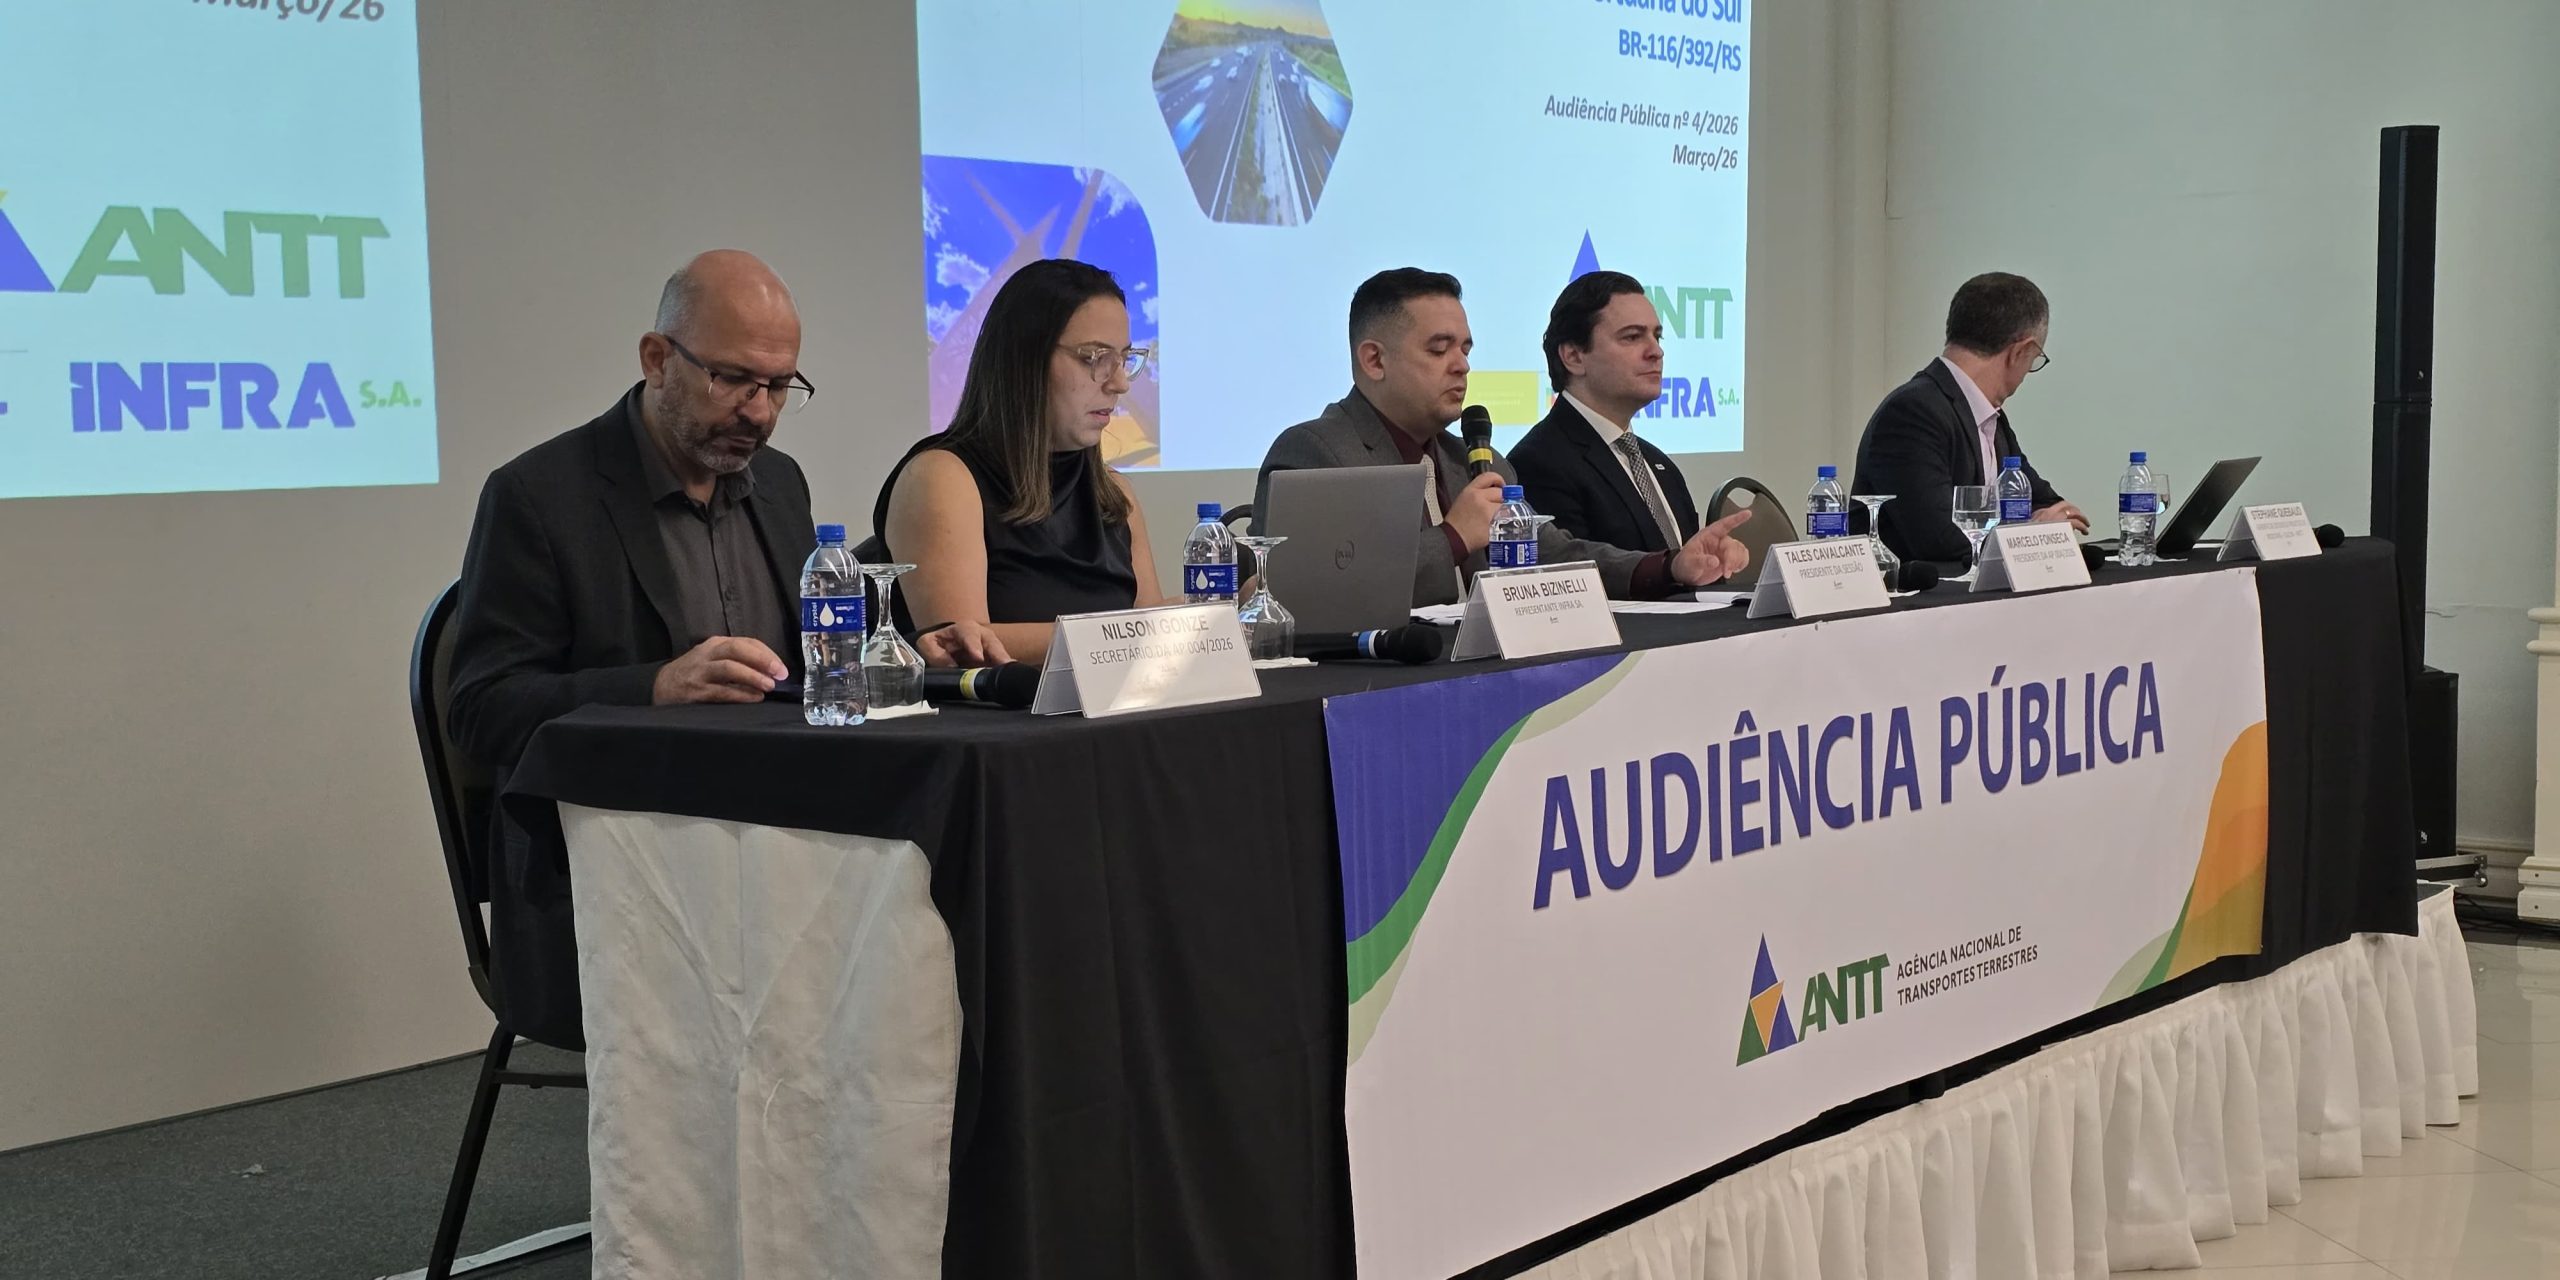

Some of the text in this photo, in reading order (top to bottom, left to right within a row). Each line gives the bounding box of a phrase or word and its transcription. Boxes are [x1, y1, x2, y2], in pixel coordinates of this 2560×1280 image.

[1619, 28, 1742, 73] BR-116/392/RS
[1544, 95, 1739, 136] Audiência Pública nº 4/2026
[1672, 144, 1738, 171] Março/26
[57, 205, 390, 299] ANTT
[1644, 286, 1733, 339] NTT
[69, 362, 422, 432] INFRA S.A.
[1634, 377, 1740, 418] FRA S.A.
[1784, 543, 1866, 564] TALES CAVALCANTE
[2006, 532, 2070, 549] MARCELO FONSECA
[1502, 578, 1588, 601] BRUNA BIZINELLI
[1799, 565, 1834, 579] PRESIDENTE
[1833, 565, 1842, 575] DA
[1101, 614, 1210, 641] NILSON GONZE
[1514, 602, 1558, 616] REPRESENTANTE
[1558, 600, 1575, 611] INFRA
[1090, 644, 1156, 665] SECRETÁRIO
[1157, 645, 1172, 659] DA
[1187, 636, 1234, 655] 004/2026
[1532, 662, 2165, 910] AUDIÊNCIA PÚBLICA
[1897, 925, 2022, 981] AGÊNCIA NACIONAL DE
[1897, 944, 2038, 1006] TRANSPORTES TERRESTRES
[1798, 953, 1890, 1042] ANTT
